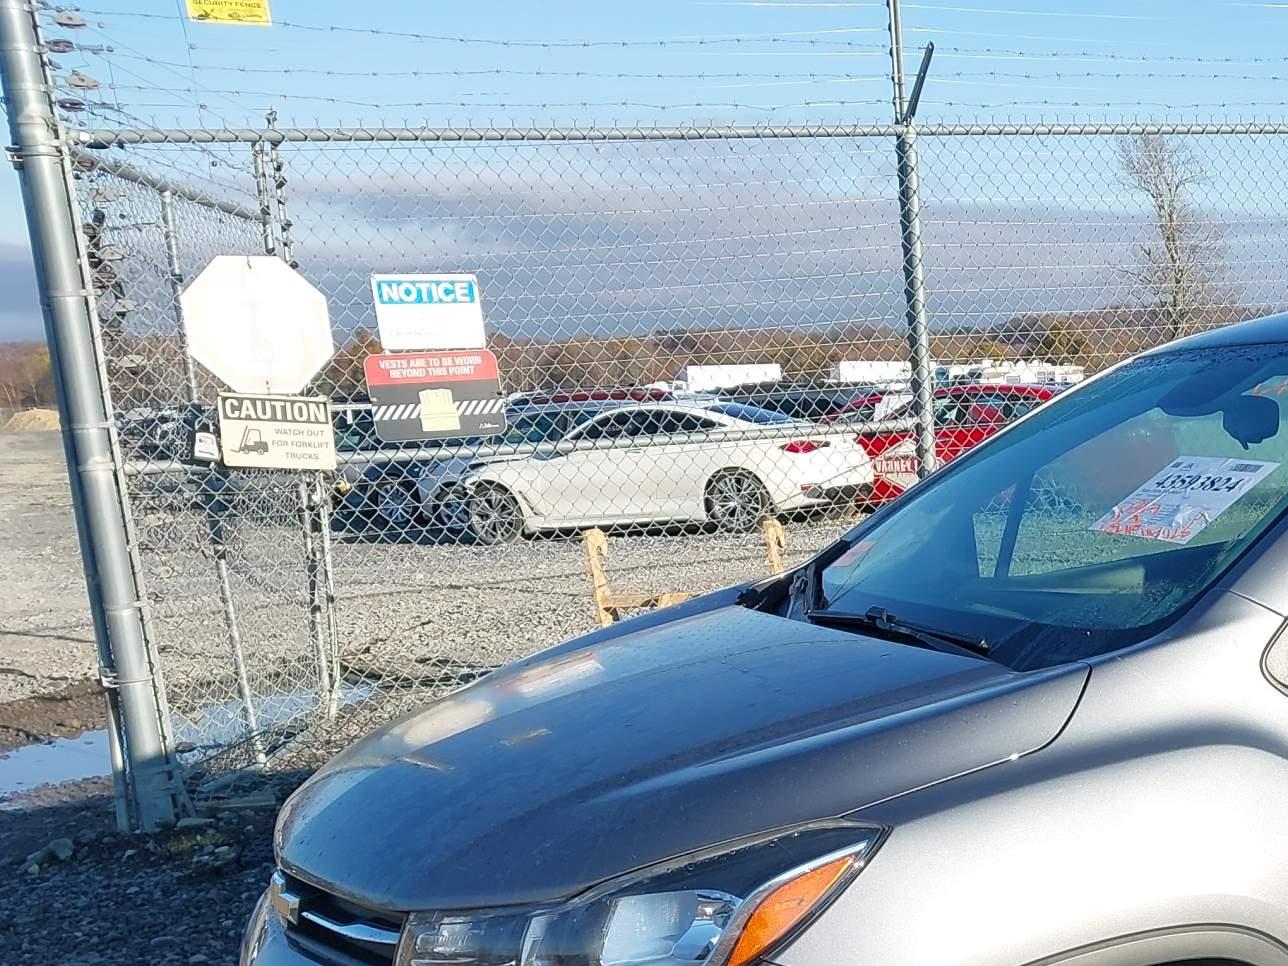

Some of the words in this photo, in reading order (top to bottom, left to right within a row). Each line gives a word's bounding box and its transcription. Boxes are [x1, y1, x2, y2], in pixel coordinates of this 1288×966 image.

[380, 281, 469, 302] NOTICE
[379, 359, 408, 369] VESTS
[409, 358, 426, 368] ARE
[429, 358, 440, 367] TO
[442, 357, 454, 366] BE
[454, 355, 483, 365] WORN
[389, 368, 426, 378] BEYOND
[428, 367, 447, 377] THIS
[448, 366, 475, 376] POINT
[225, 398, 327, 423] CAUTION
[274, 428, 305, 436] WATCH
[306, 429, 325, 437] OUT
[290, 441, 329, 449] FORKLIFT
[285, 452, 319, 460] TRUCKS
[1155, 473, 1245, 493] 43593824
